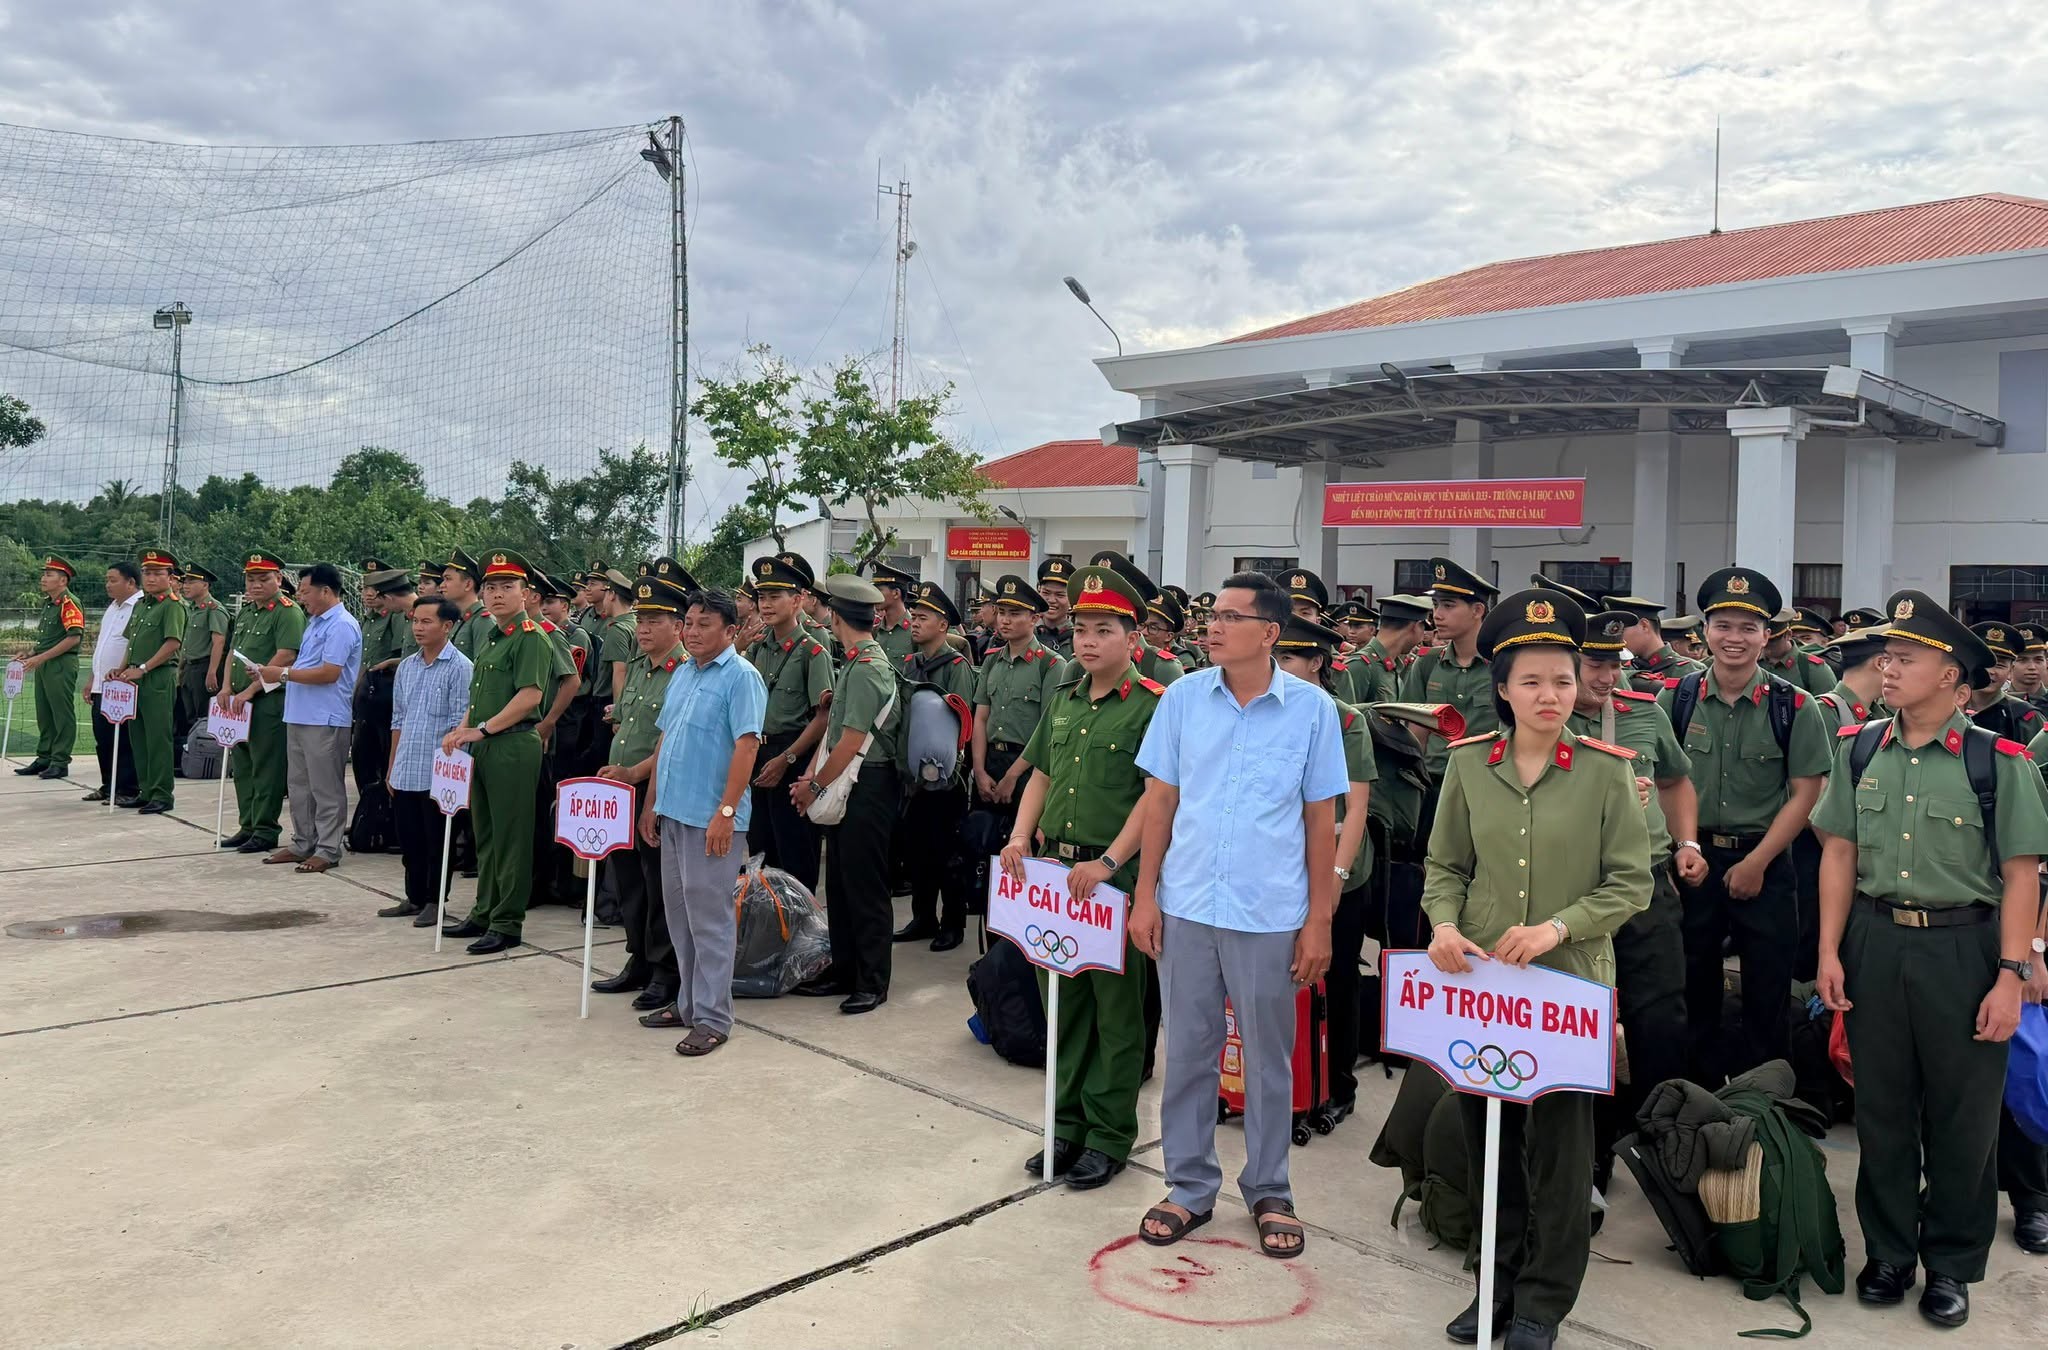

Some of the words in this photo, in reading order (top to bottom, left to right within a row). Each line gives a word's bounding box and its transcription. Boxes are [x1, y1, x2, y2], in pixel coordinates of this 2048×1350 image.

[1332, 491, 1350, 503] NHIỆT
[1351, 491, 1365, 503] LIỆT
[1365, 490, 1384, 502] CHÀO
[1403, 489, 1422, 501] ĐOÀN
[1422, 491, 1437, 503] HỌC
[1438, 489, 1455, 501] VIÊN
[1455, 489, 1475, 501] KHÓA
[1476, 491, 1488, 501] D33
[1493, 488, 1521, 501] TRƯỜNG
[1522, 490, 1536, 502] ĐẠI
[1537, 490, 1553, 502] HỌC
[1555, 489, 1575, 500] ANND
[1351, 506, 1365, 519] ĐẾN
[1365, 509, 1382, 520] HOẠT
[1383, 506, 1403, 520] ĐỘNG
[1404, 507, 1423, 520] THỰC
[1423, 505, 1434, 519] TẾ
[1434, 508, 1446, 520] TẠI
[1446, 506, 1457, 519] XÃ
[1458, 506, 1473, 519] TÂN
[1497, 505, 1516, 519] TỈNH
[1516, 505, 1528, 519] CÀ
[1528, 508, 1547, 519] MAU
[105, 685, 111, 699] ẤP
[112, 687, 120, 701] TÂN
[435, 755, 442, 775] ẤP
[443, 758, 451, 778] CÁI
[452, 760, 467, 782] GIẾNG
[570, 791, 582, 817] ẤP
[585, 794, 601, 818] CÁI
[604, 795, 618, 820] RÔ
[1028, 883, 1060, 914] CÁI
[1399, 968, 1435, 1011] ẤP
[1442, 985, 1532, 1029] TRỌNG
[1541, 1001, 1599, 1040] BAN
